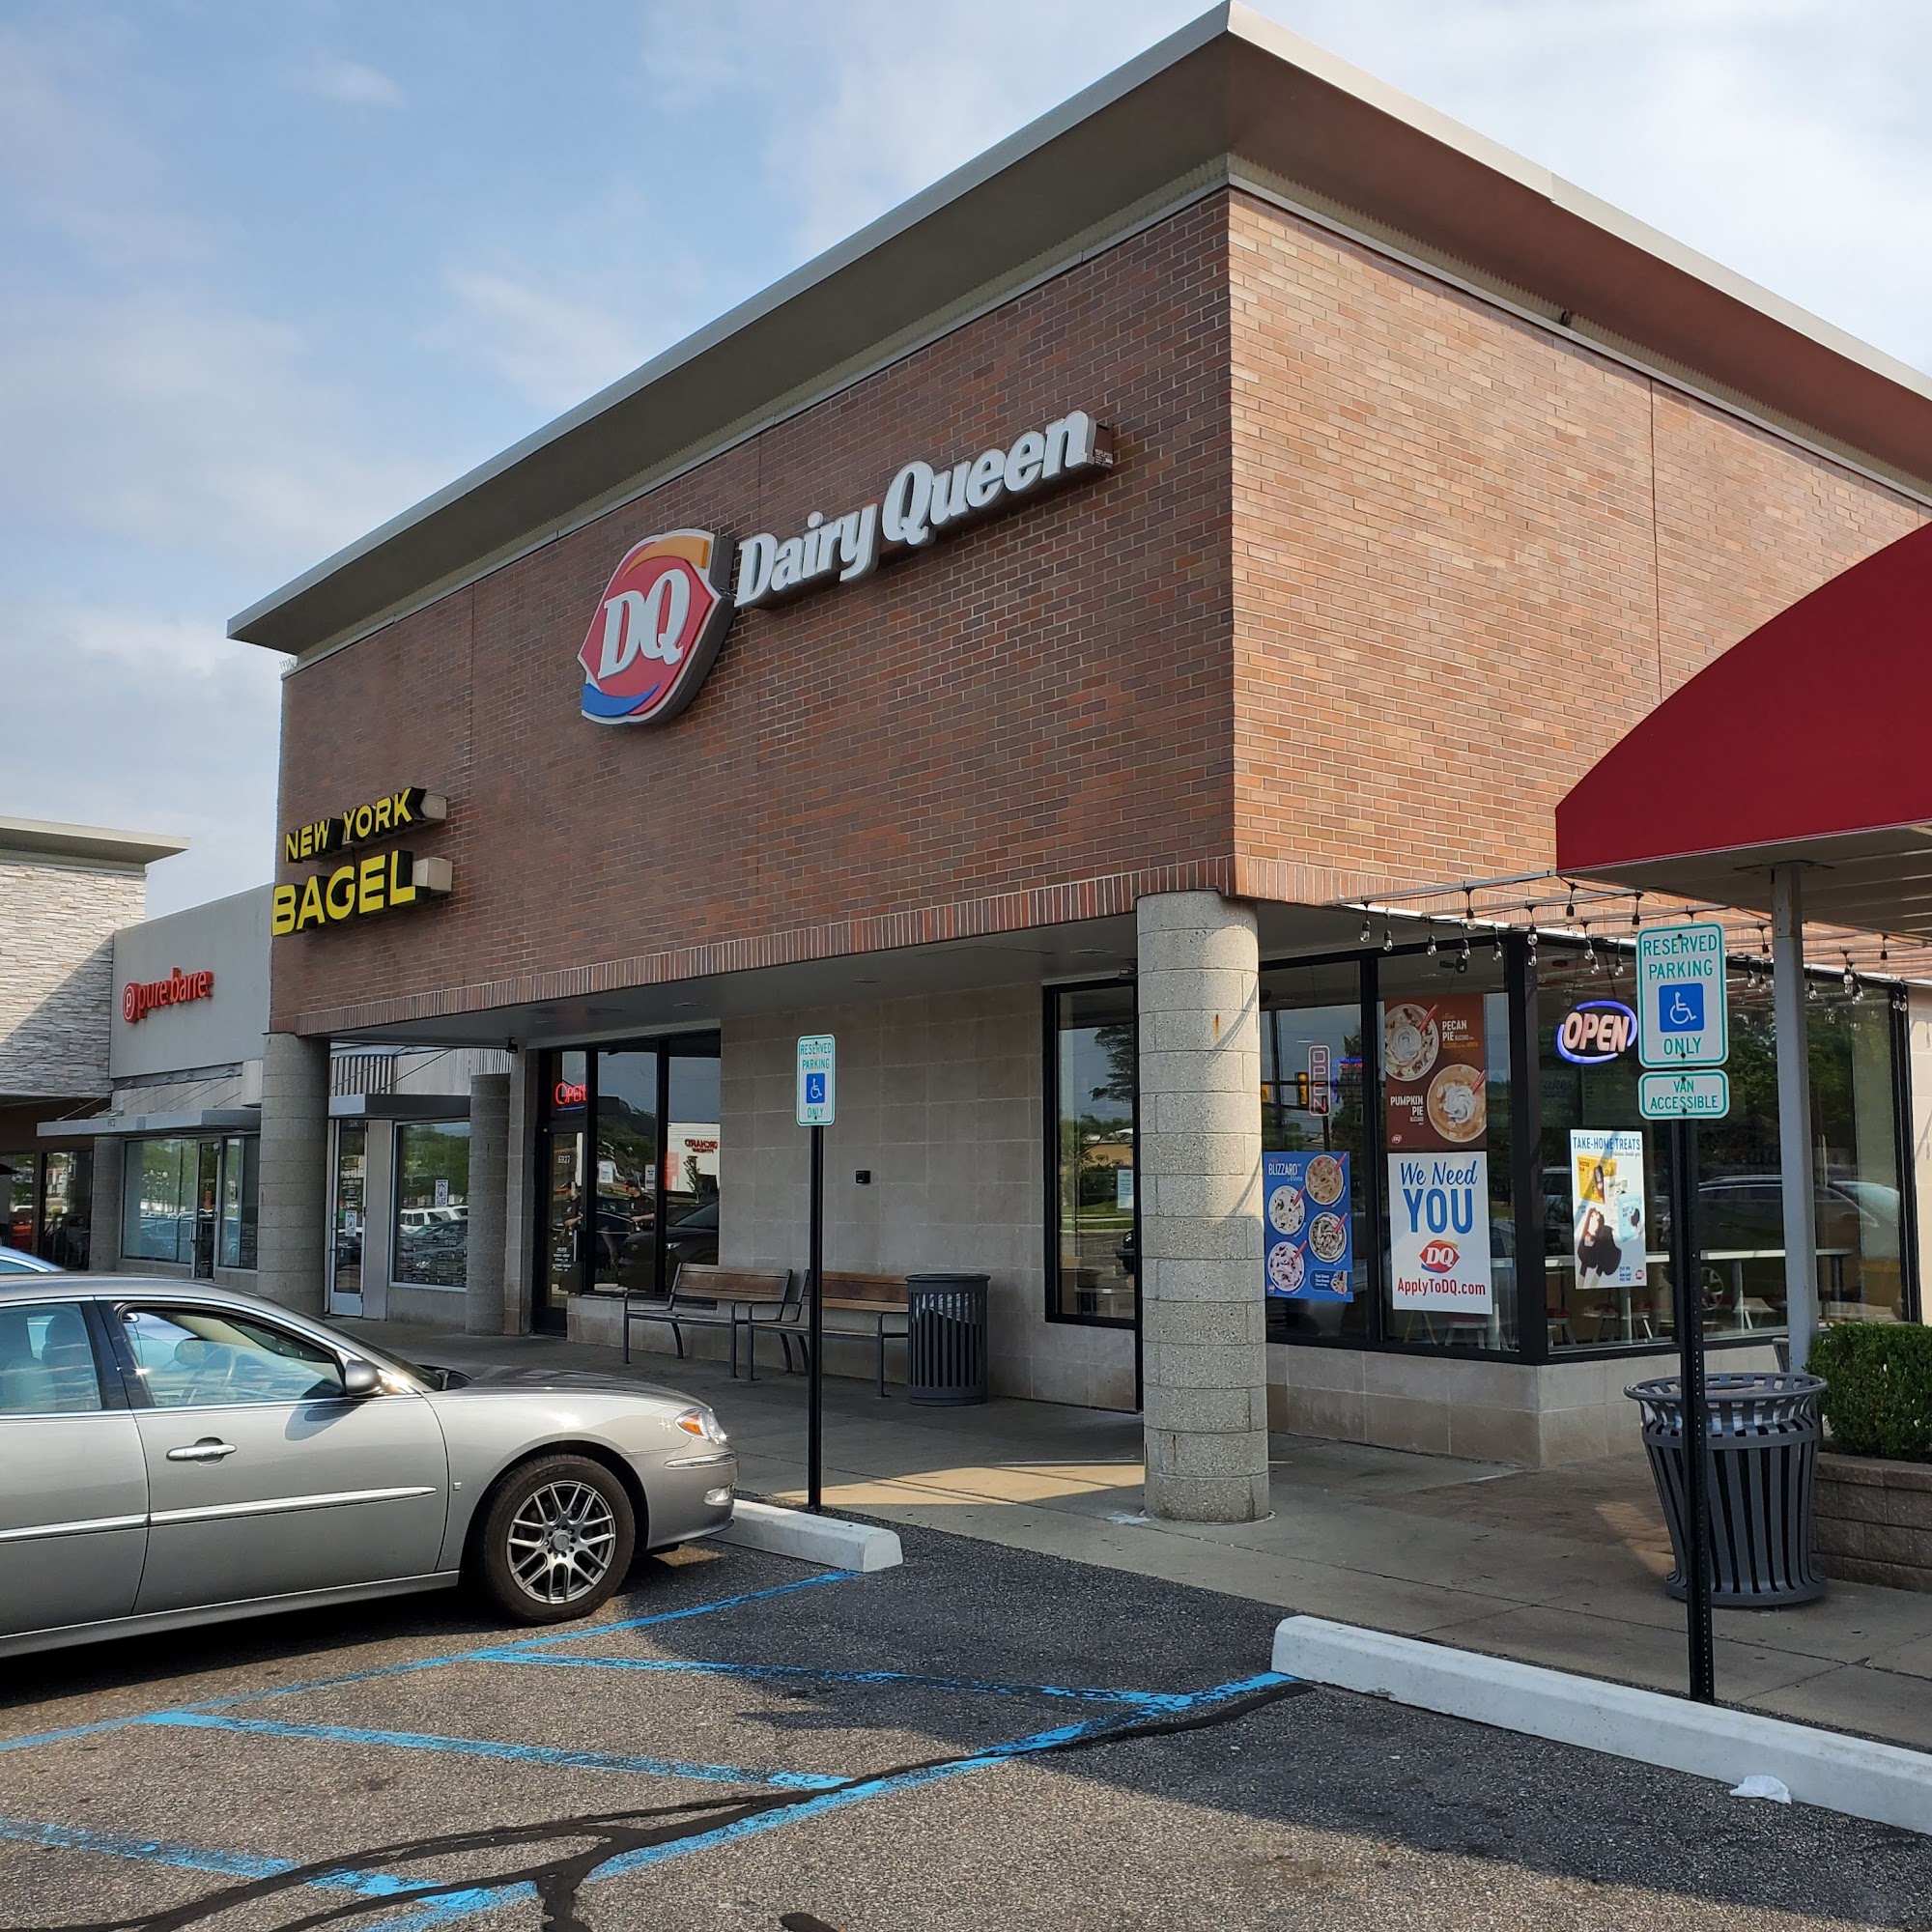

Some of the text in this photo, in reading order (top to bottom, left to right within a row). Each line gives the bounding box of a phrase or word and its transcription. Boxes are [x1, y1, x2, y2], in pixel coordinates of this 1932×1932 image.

[734, 410, 1094, 608] Dairy Queen
[597, 568, 692, 680] DQ
[285, 787, 412, 863] NEW YORK
[271, 850, 416, 936] BAGEL
[1643, 934, 1718, 957] RESERVED
[1648, 959, 1714, 980] PARKING
[137, 980, 167, 1019] pure
[170, 967, 208, 1003] barre
[1442, 1019, 1467, 1031] PECAN
[1562, 1011, 1630, 1053] OPEN
[1442, 1031, 1455, 1041] PIE
[800, 1043, 832, 1056] RESERVED
[1662, 1037, 1702, 1056] ONLY
[802, 1059, 830, 1070] PARKING
[1313, 1050, 1326, 1113] OPEN
[1673, 1079, 1694, 1094] VAN
[1390, 1094, 1424, 1107] PUMPKIN
[1650, 1094, 1719, 1110] ACCESSIBLE
[807, 1107, 824, 1119] ONLY
[1411, 1106, 1424, 1116] PIE
[1614, 1137, 1641, 1151] TREATS
[1268, 1162, 1298, 1177] BLIZZARD
[1400, 1160, 1478, 1186] We Need
[1402, 1188, 1473, 1235] YOU
[1425, 1246, 1455, 1268] DQ
[1397, 1277, 1486, 1296] ApplyToDQ.com
